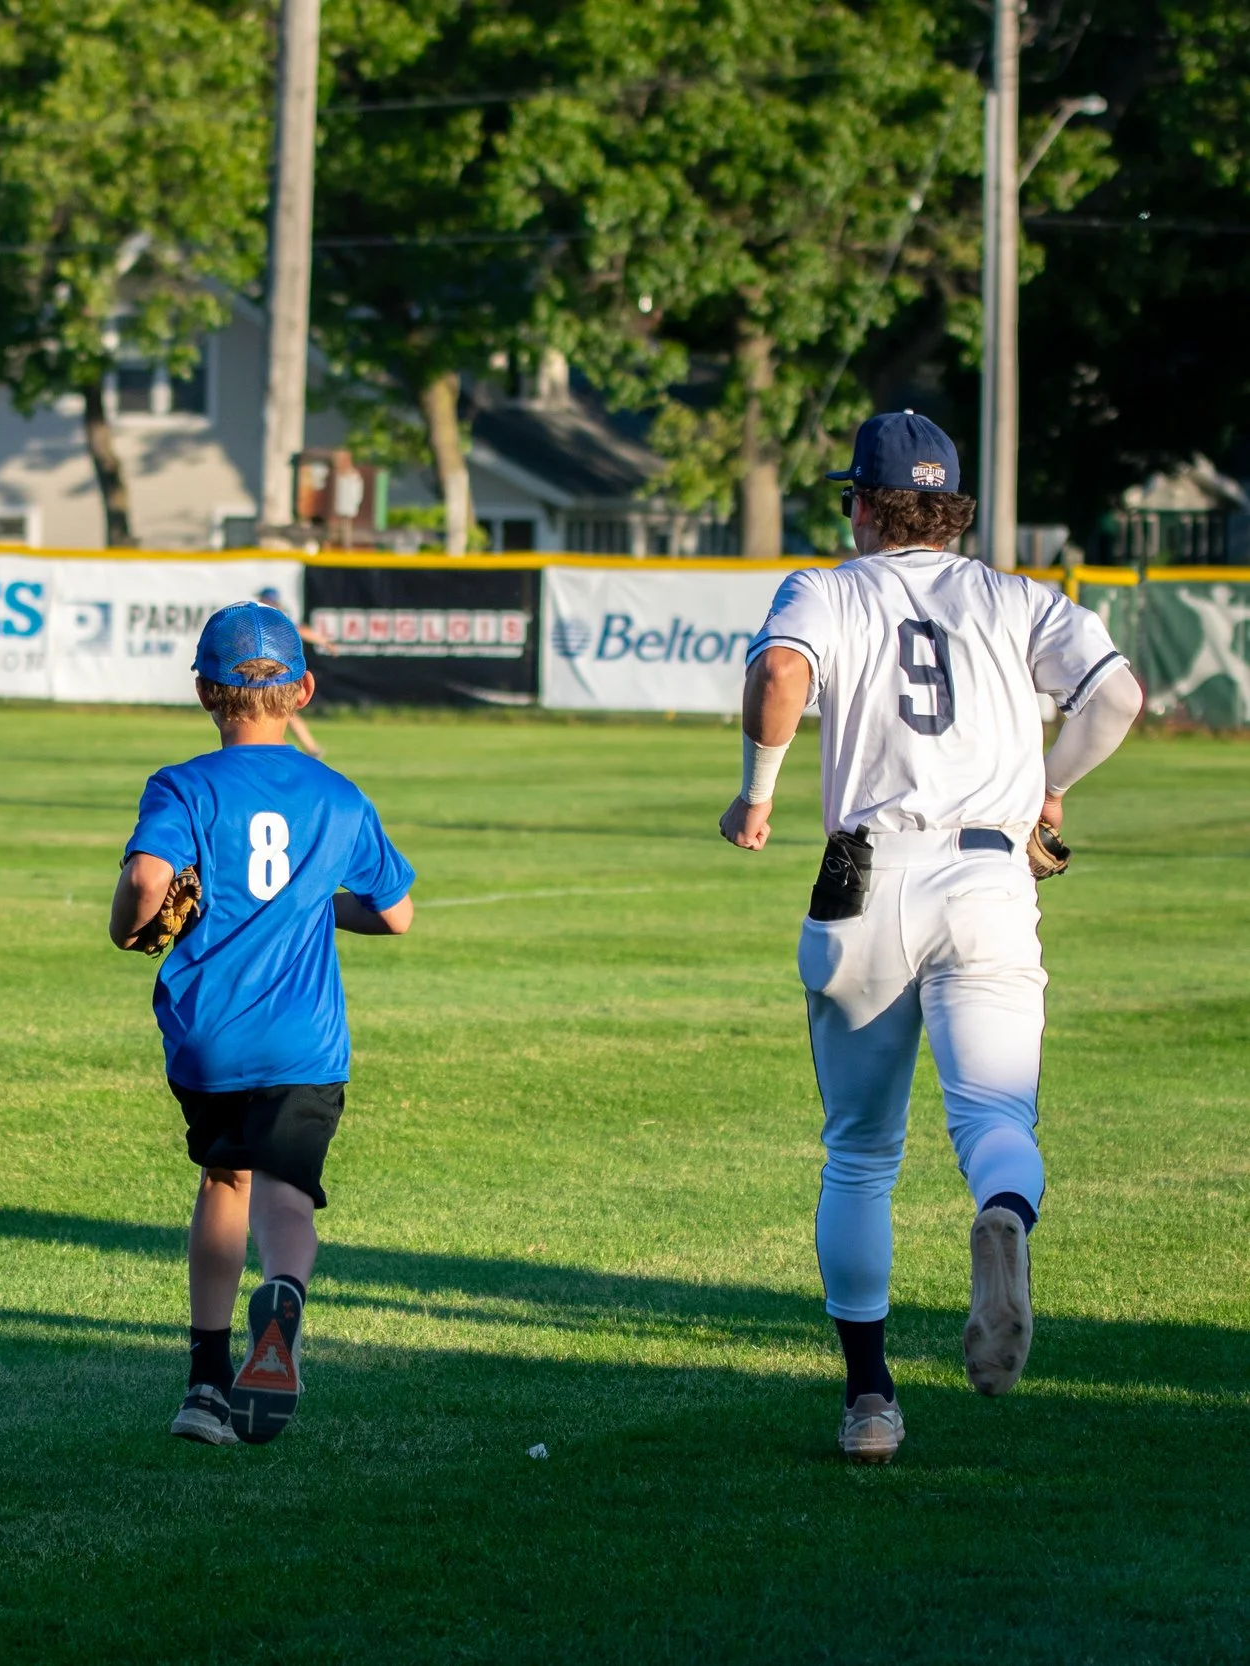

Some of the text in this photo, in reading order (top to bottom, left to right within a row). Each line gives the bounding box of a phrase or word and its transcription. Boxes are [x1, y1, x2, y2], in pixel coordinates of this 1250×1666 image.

[127, 603, 219, 635] PARM
[315, 611, 526, 643] LANGLOIS
[126, 639, 176, 657] LAW
[897, 617, 956, 737] 9
[249, 812, 291, 901] 8
